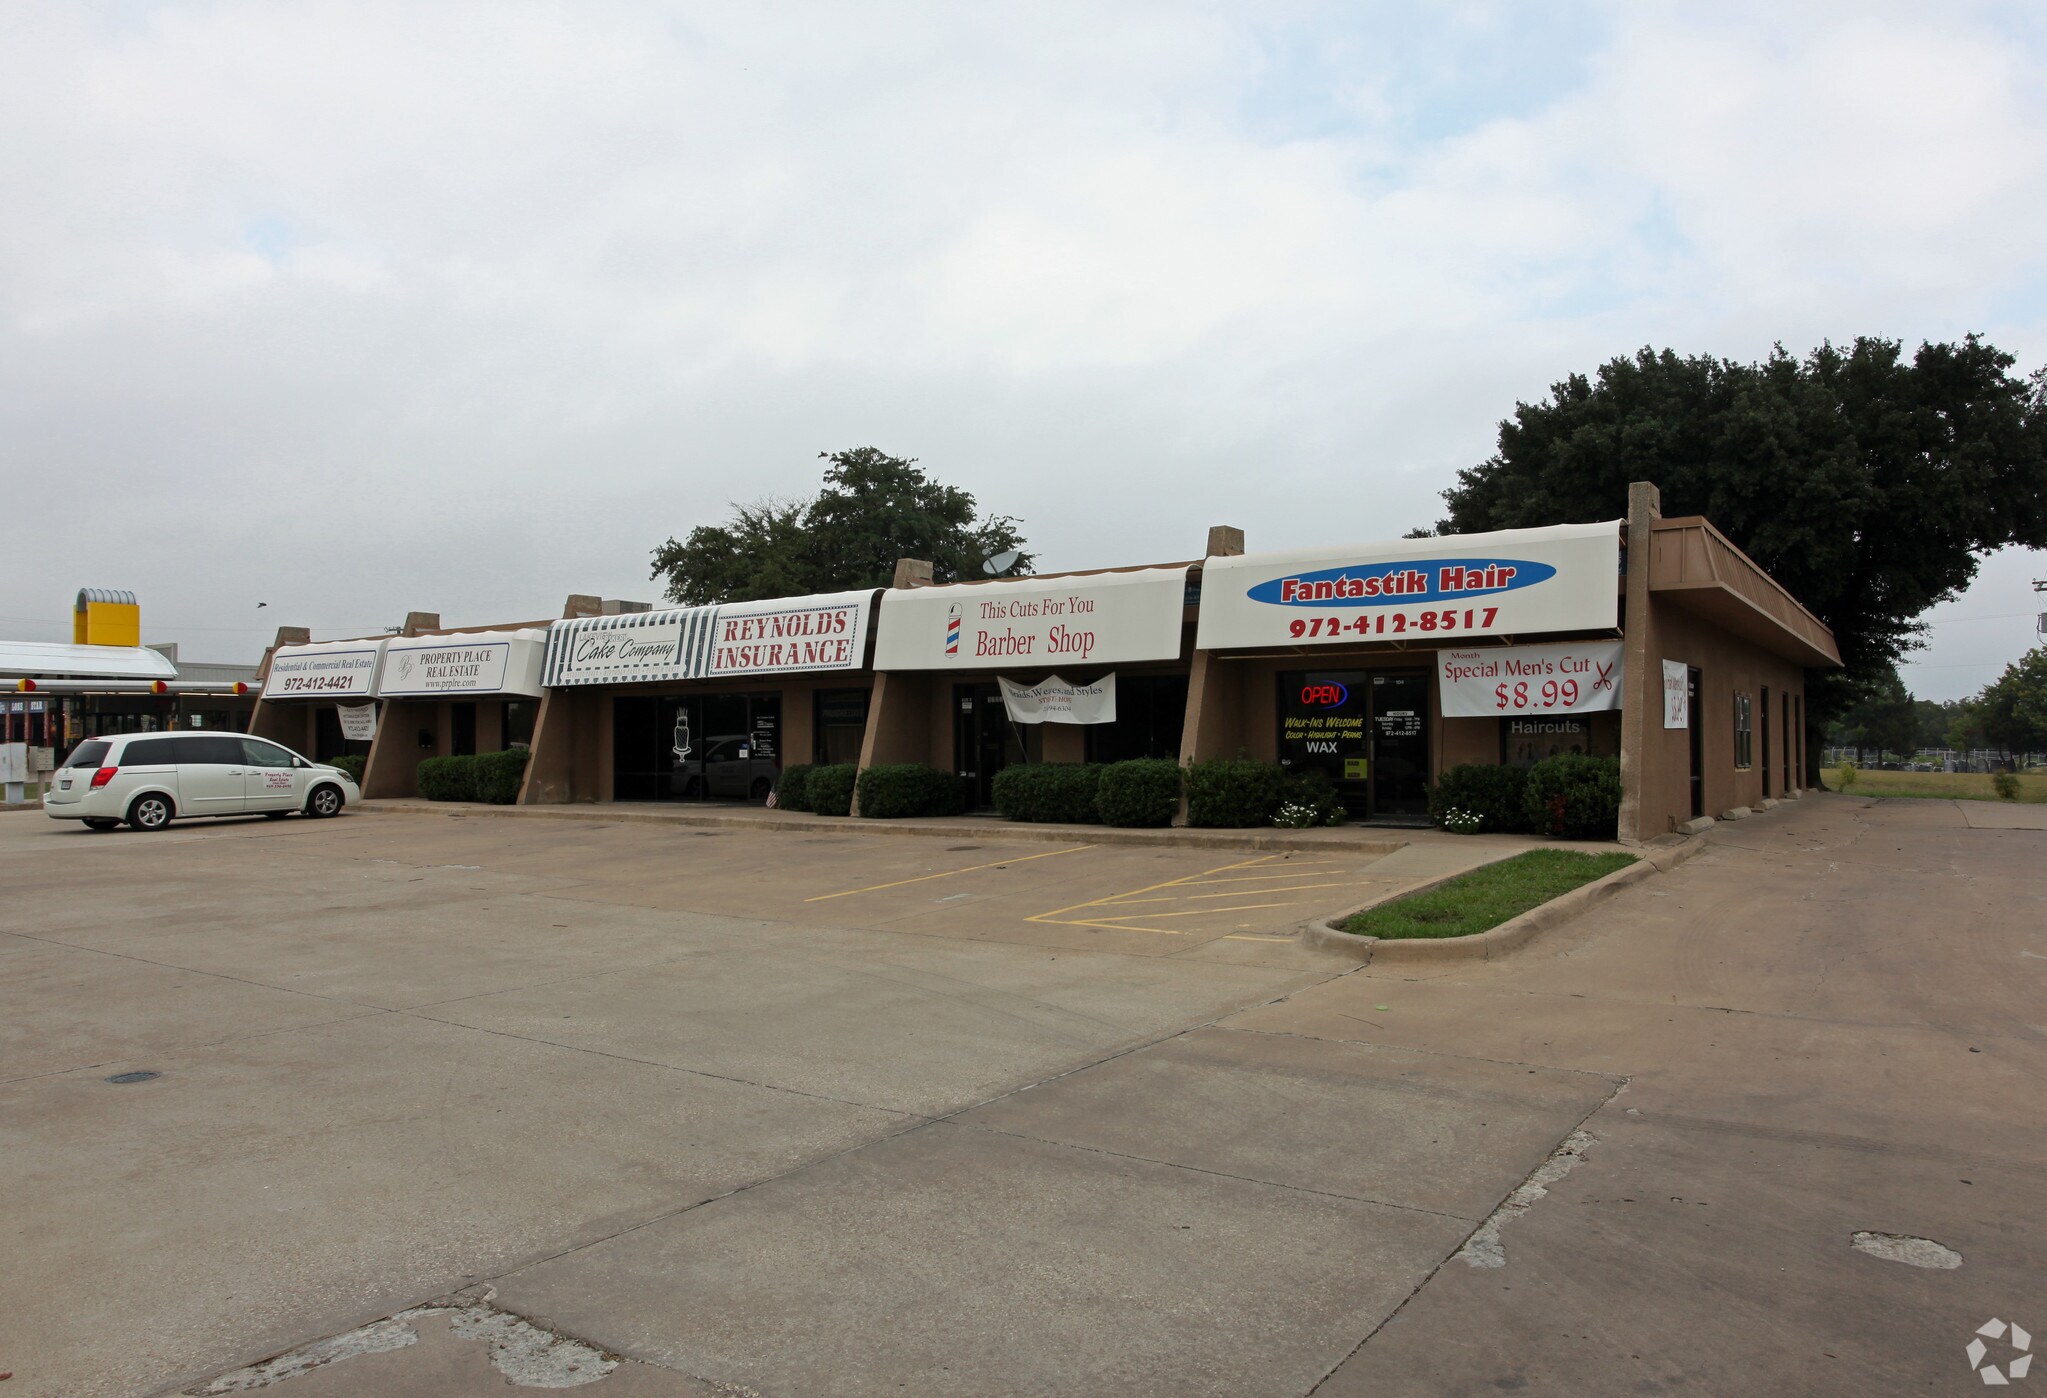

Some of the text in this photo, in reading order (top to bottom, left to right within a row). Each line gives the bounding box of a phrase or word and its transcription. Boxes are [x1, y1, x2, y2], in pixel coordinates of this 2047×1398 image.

[1281, 563, 1516, 603] Fantastik Hair
[980, 596, 1094, 619] This Cuts For You
[723, 610, 847, 642] REYNOLDS
[1290, 607, 1499, 638] 972-412-8517
[577, 637, 675, 662] Cake Company
[975, 624, 1095, 659] Barber Shop
[420, 650, 492, 665] PROPERTY PLACE
[715, 638, 850, 669] INSURANCE
[274, 658, 373, 672] Residential & Commercial Real Estate
[426, 666, 447, 678] REAL
[449, 664, 480, 677] ESTATE
[1445, 656, 1590, 683] Special Men's Cut
[284, 675, 353, 690] 972-412-4421
[425, 679, 476, 690] www.prplre.com
[1076, 686, 1103, 697] Styles
[1301, 686, 1340, 704] OPEN
[1495, 679, 1579, 710] $8.99
[30, 701, 43, 710] STAR
[1285, 730, 1362, 739] COLOR HIGHLIGHT PERMS
[1511, 720, 1580, 734] Haircuts
[1306, 741, 1338, 753] WAX
